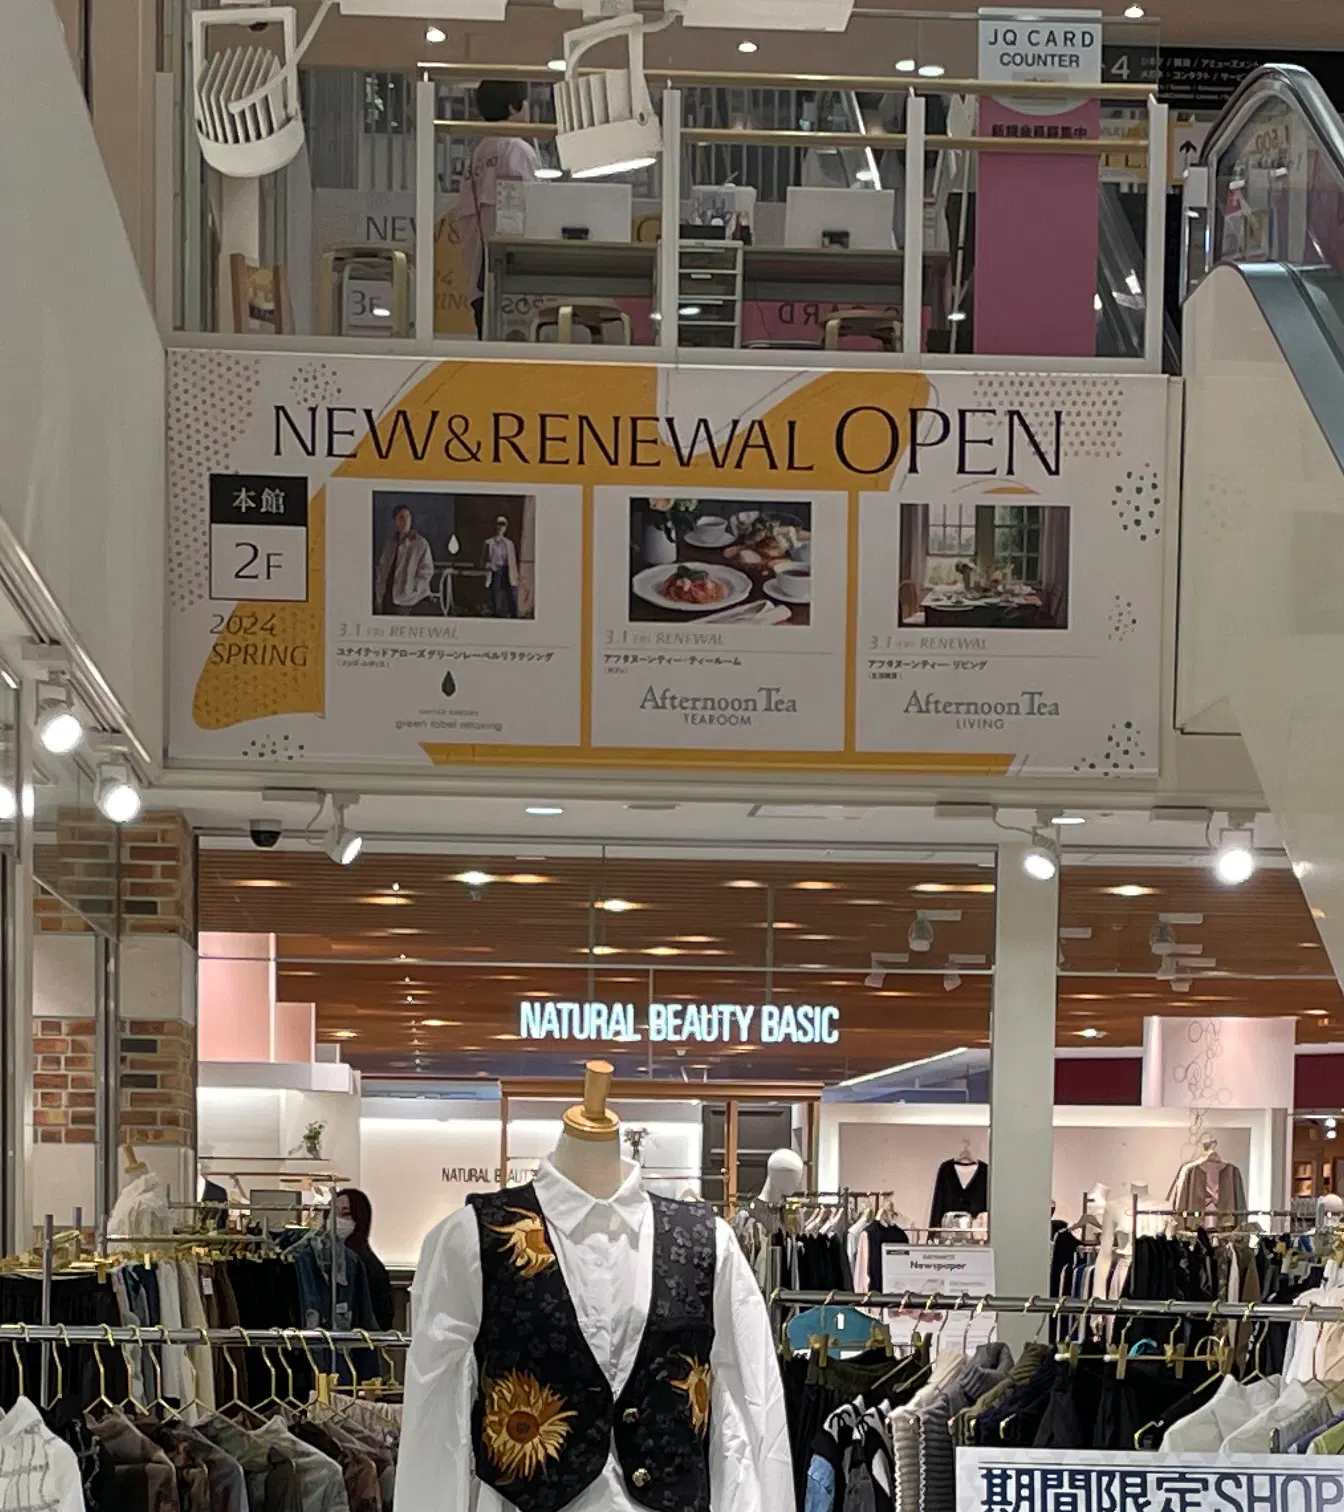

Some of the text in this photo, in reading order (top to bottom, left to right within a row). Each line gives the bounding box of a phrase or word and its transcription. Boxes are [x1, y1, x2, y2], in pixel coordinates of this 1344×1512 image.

[988, 29, 1095, 48] JQ CARD
[999, 52, 1081, 68] COUNTER
[1110, 55, 1131, 80] 4
[272, 404, 1064, 477] NEW&RENEWAL OPEN
[232, 486, 286, 515] 本館
[233, 542, 285, 580] 2F
[208, 613, 277, 637] 2024
[389, 625, 458, 640] RENEWAL
[655, 631, 725, 645] RENEWAL
[919, 636, 987, 651] RENEWAL
[212, 642, 309, 668] SPRING
[639, 685, 798, 713] Afternoon Tea
[903, 689, 1061, 717] Afternoon Tea
[683, 712, 753, 727] TEAROOM
[956, 718, 1005, 731] LIVING
[520, 1000, 841, 1045] NATURAL BEAUTY BASIC
[441, 1167, 491, 1184] NATURAL
